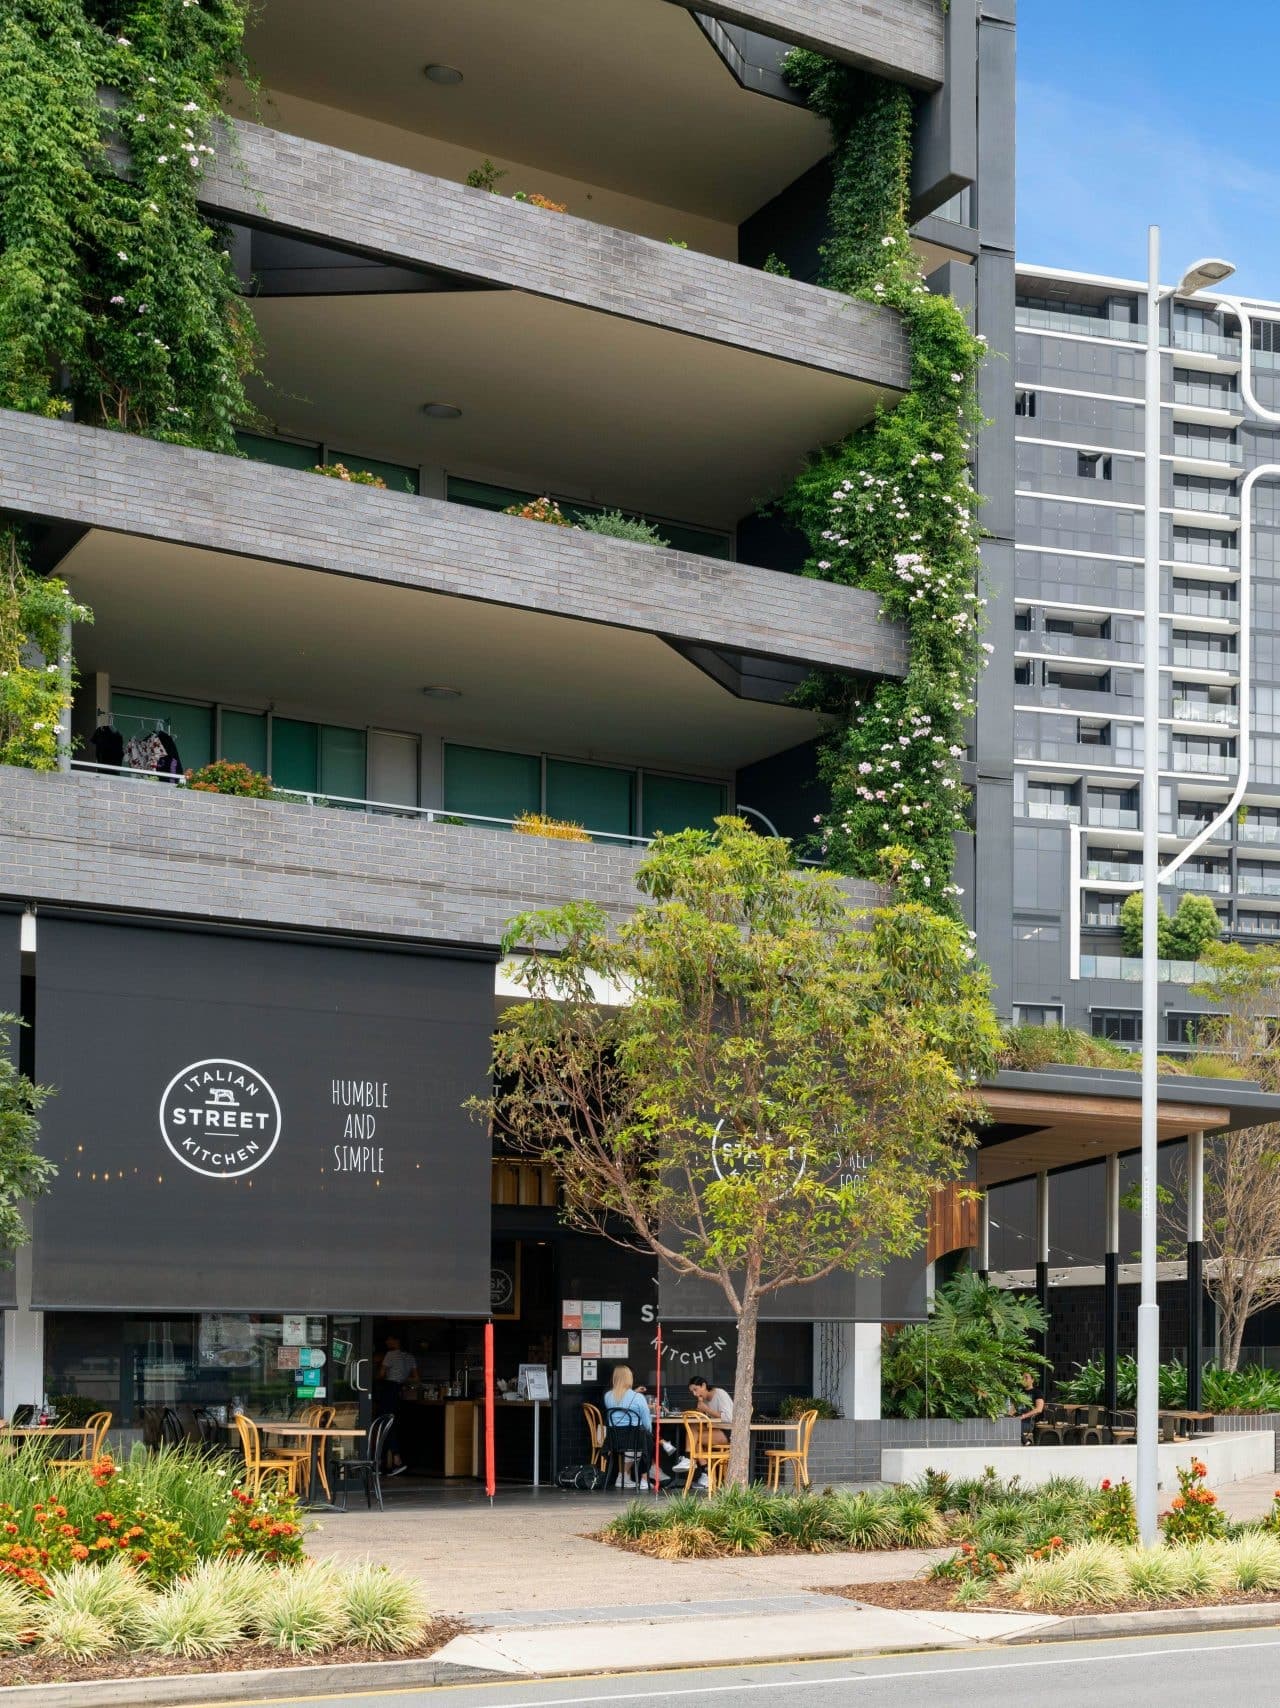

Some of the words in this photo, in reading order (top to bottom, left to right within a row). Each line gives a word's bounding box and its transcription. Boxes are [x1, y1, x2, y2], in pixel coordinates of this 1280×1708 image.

[184, 1070, 259, 1098] ITALIAN
[332, 1079, 389, 1108] HUMBLE
[173, 1108, 270, 1130] STREET
[343, 1113, 376, 1139] AND
[182, 1137, 260, 1165] KITCHEN
[334, 1144, 385, 1173] SIMPLE
[722, 1142, 797, 1161] STRT
[650, 1335, 727, 1365] KITCHEN
